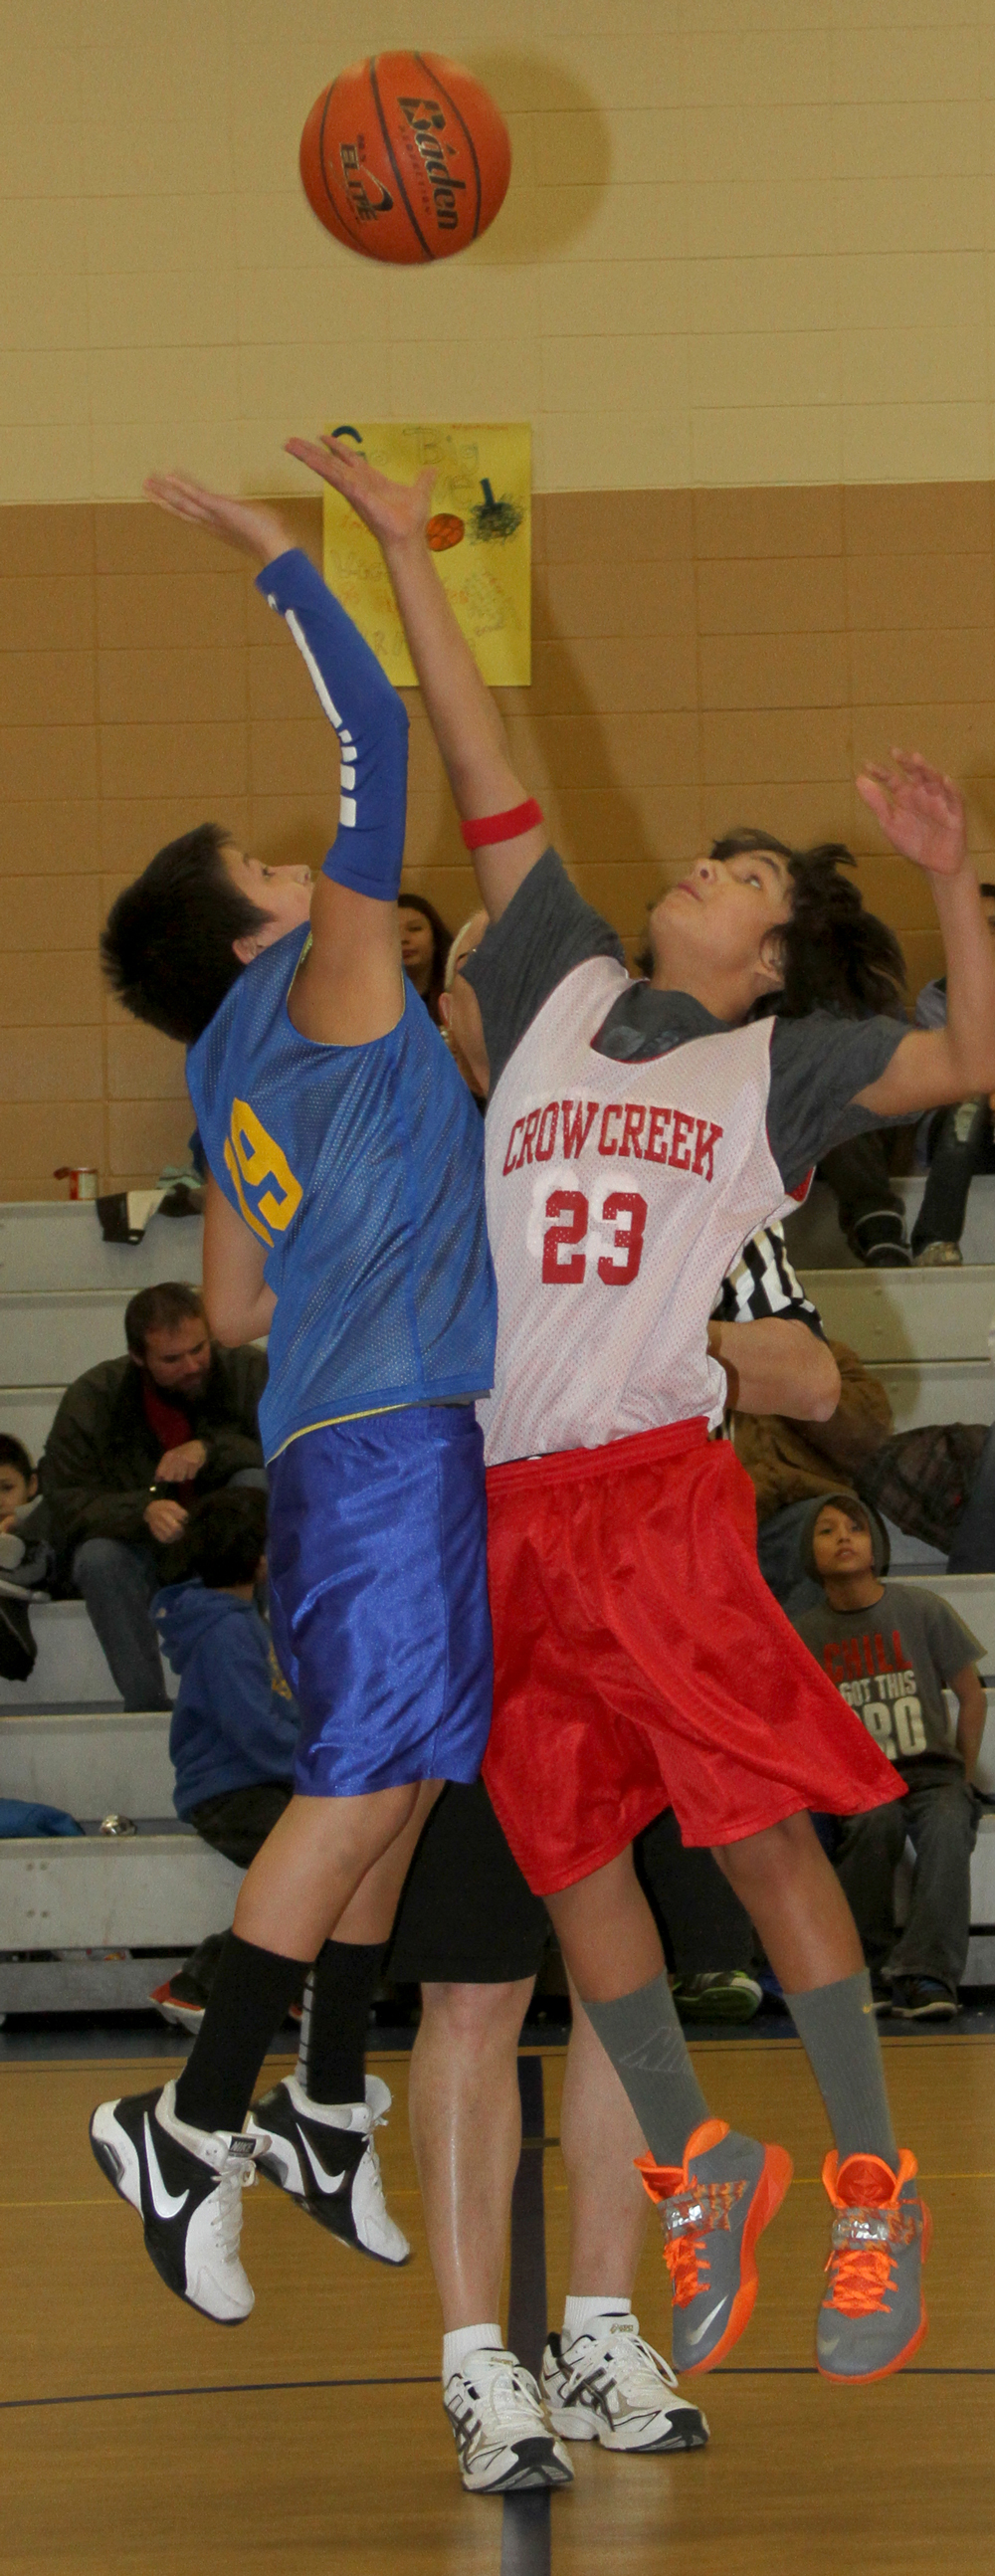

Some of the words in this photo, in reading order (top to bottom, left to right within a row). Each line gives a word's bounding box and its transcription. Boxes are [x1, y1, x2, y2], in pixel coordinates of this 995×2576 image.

[339, 142, 378, 221] ELITE
[502, 1099, 599, 1177] CROW
[597, 1102, 723, 1183] CREEK
[541, 1190, 648, 1286] 23
[824, 1631, 912, 1684] CHILL
[839, 1679, 871, 1707] GOT
[874, 1671, 917, 1700] THIS
[853, 1695, 926, 1760] RO
[230, 2139, 255, 2152] NIKE
